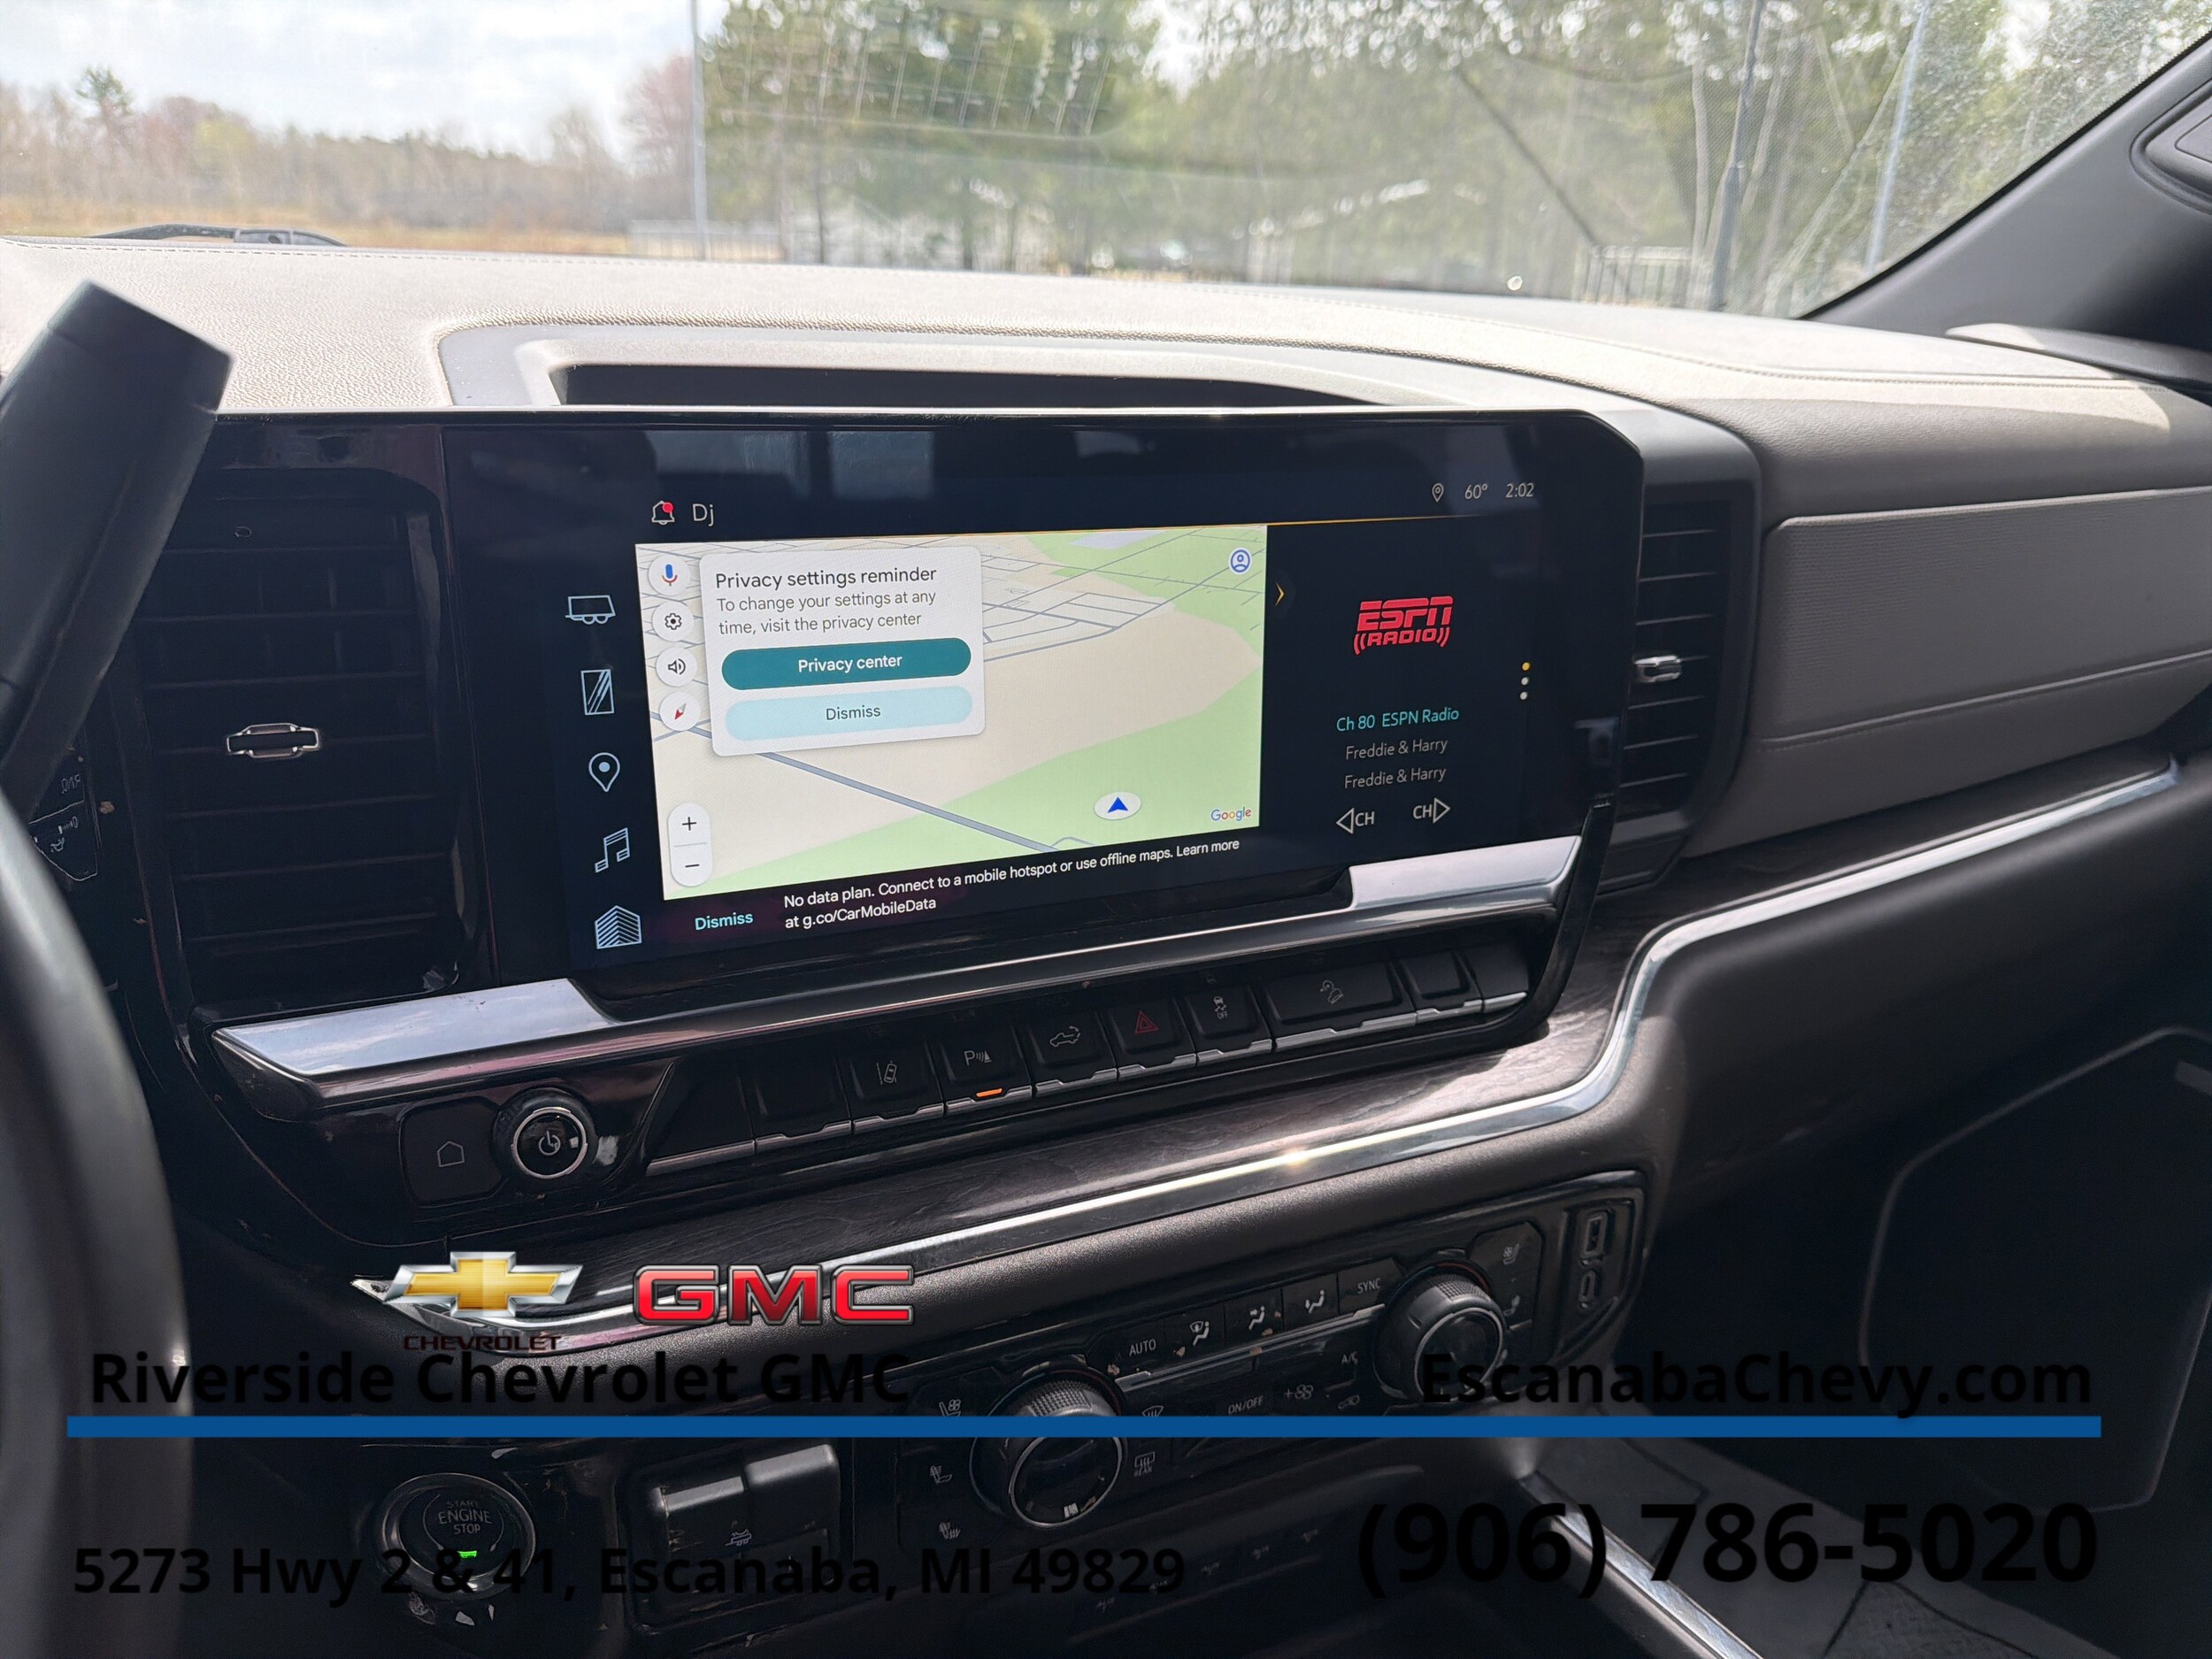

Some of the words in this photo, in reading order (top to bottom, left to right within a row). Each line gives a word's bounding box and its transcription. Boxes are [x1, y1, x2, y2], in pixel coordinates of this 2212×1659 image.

[1505, 482, 1534, 498] 2:02
[692, 503, 715, 526] Dj
[715, 572, 782, 590] Privacy
[787, 569, 856, 588] settings
[861, 567, 937, 584] reminder
[717, 597, 735, 612] To
[739, 595, 795, 612] change
[798, 595, 831, 612] your
[834, 591, 891, 608] settings
[895, 591, 909, 603] at
[912, 591, 936, 605] any
[718, 620, 757, 635] time,
[761, 618, 791, 633] visit
[795, 617, 818, 631] the
[822, 615, 874, 633] privacy
[877, 612, 922, 627] center
[1356, 595, 1454, 632] ESPN
[1367, 627, 1438, 646] RADIO
[797, 657, 854, 674] Privacy
[856, 654, 903, 670] center
[826, 705, 881, 721] Dismiss
[1336, 717, 1355, 732] Ch
[1357, 714, 1376, 730] 80
[1382, 710, 1418, 727] ESPN
[1422, 707, 1460, 724] Radio
[1346, 741, 1395, 760] Freddie
[1398, 740, 1409, 754] &
[1412, 738, 1448, 754] Harry
[1345, 771, 1394, 789] Freddie
[1396, 769, 1408, 783] &
[1410, 767, 1447, 782] Harry
[1210, 806, 1252, 822] Google
[1356, 811, 1375, 826] CH
[1412, 803, 1432, 819] CH
[784, 894, 805, 909] No
[807, 890, 839, 905] data
[842, 887, 875, 904] plan.
[879, 878, 934, 896] Connect
[937, 876, 951, 888] to
[953, 875, 962, 886] a
[964, 868, 1007, 884] mobile
[1010, 862, 1057, 881] hotspot
[1060, 859, 1073, 872] or
[1076, 857, 1097, 871] use
[1099, 852, 1137, 868] offline
[1139, 848, 1174, 864] maps.
[1176, 843, 1209, 858] Learn
[1210, 840, 1240, 853] more
[695, 911, 754, 931] Dismiss
[785, 916, 800, 929] at
[802, 898, 937, 929] g.co/CarMobileData
[1357, 1278, 1381, 1294] SYNC
[1129, 1339, 1157, 1356] AUTO
[1228, 1395, 1264, 1415] ON/OFF
[438, 1508, 492, 1525] ENGINE
[453, 1522, 481, 1535] STOP
